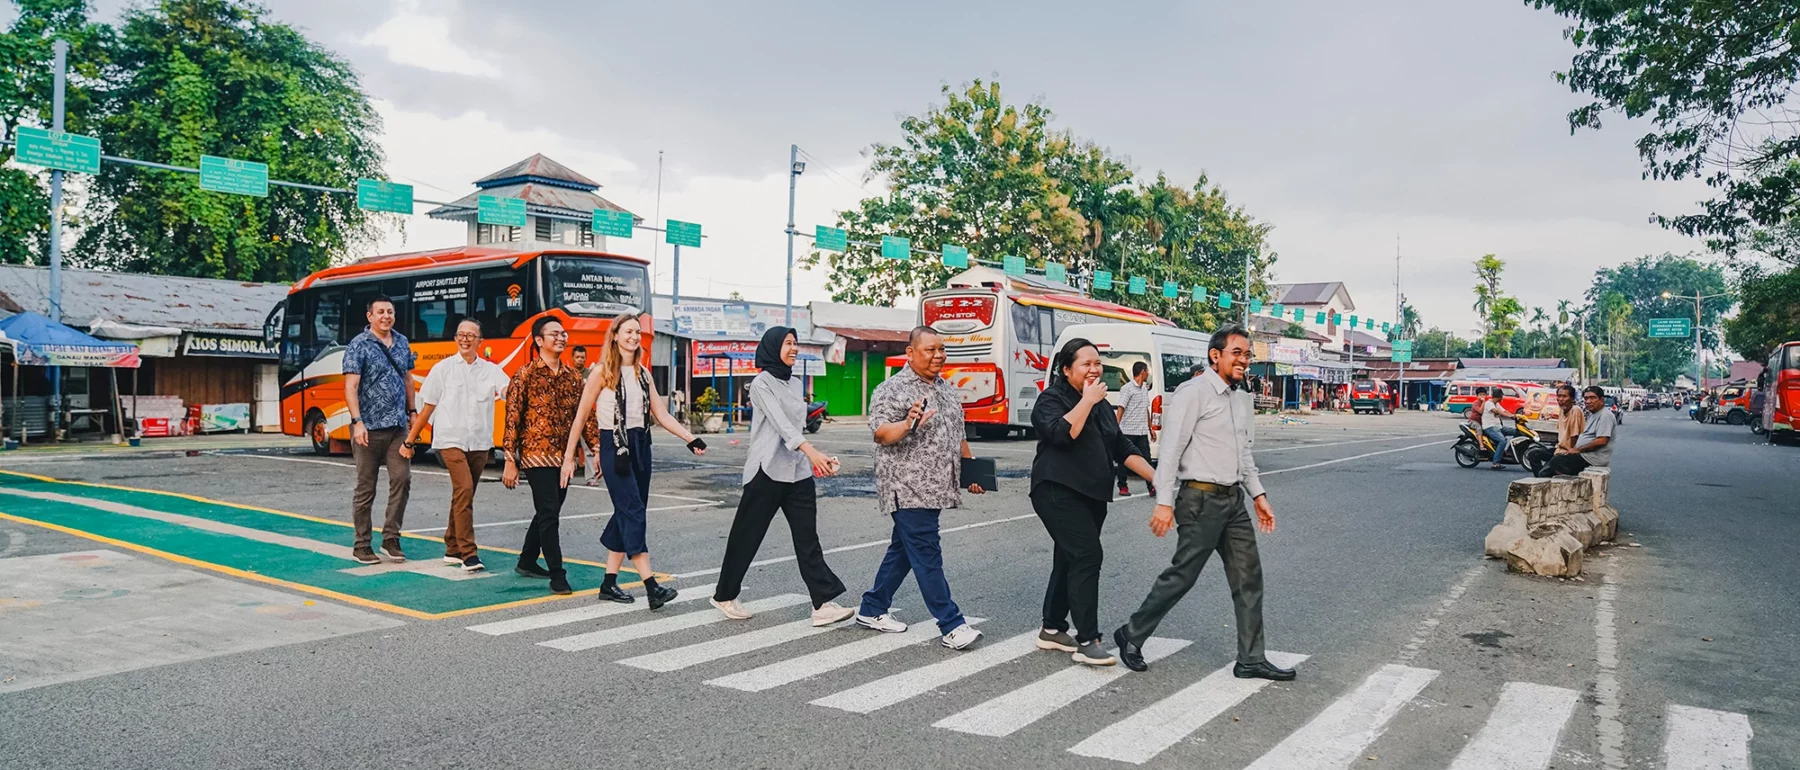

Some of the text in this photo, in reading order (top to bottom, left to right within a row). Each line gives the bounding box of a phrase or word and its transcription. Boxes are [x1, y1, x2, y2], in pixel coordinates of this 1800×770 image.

[415, 276, 469, 288] AIRPORT SHUTTLE BUS
[581, 274, 603, 282] ANTAR
[936, 299, 954, 307] SE
